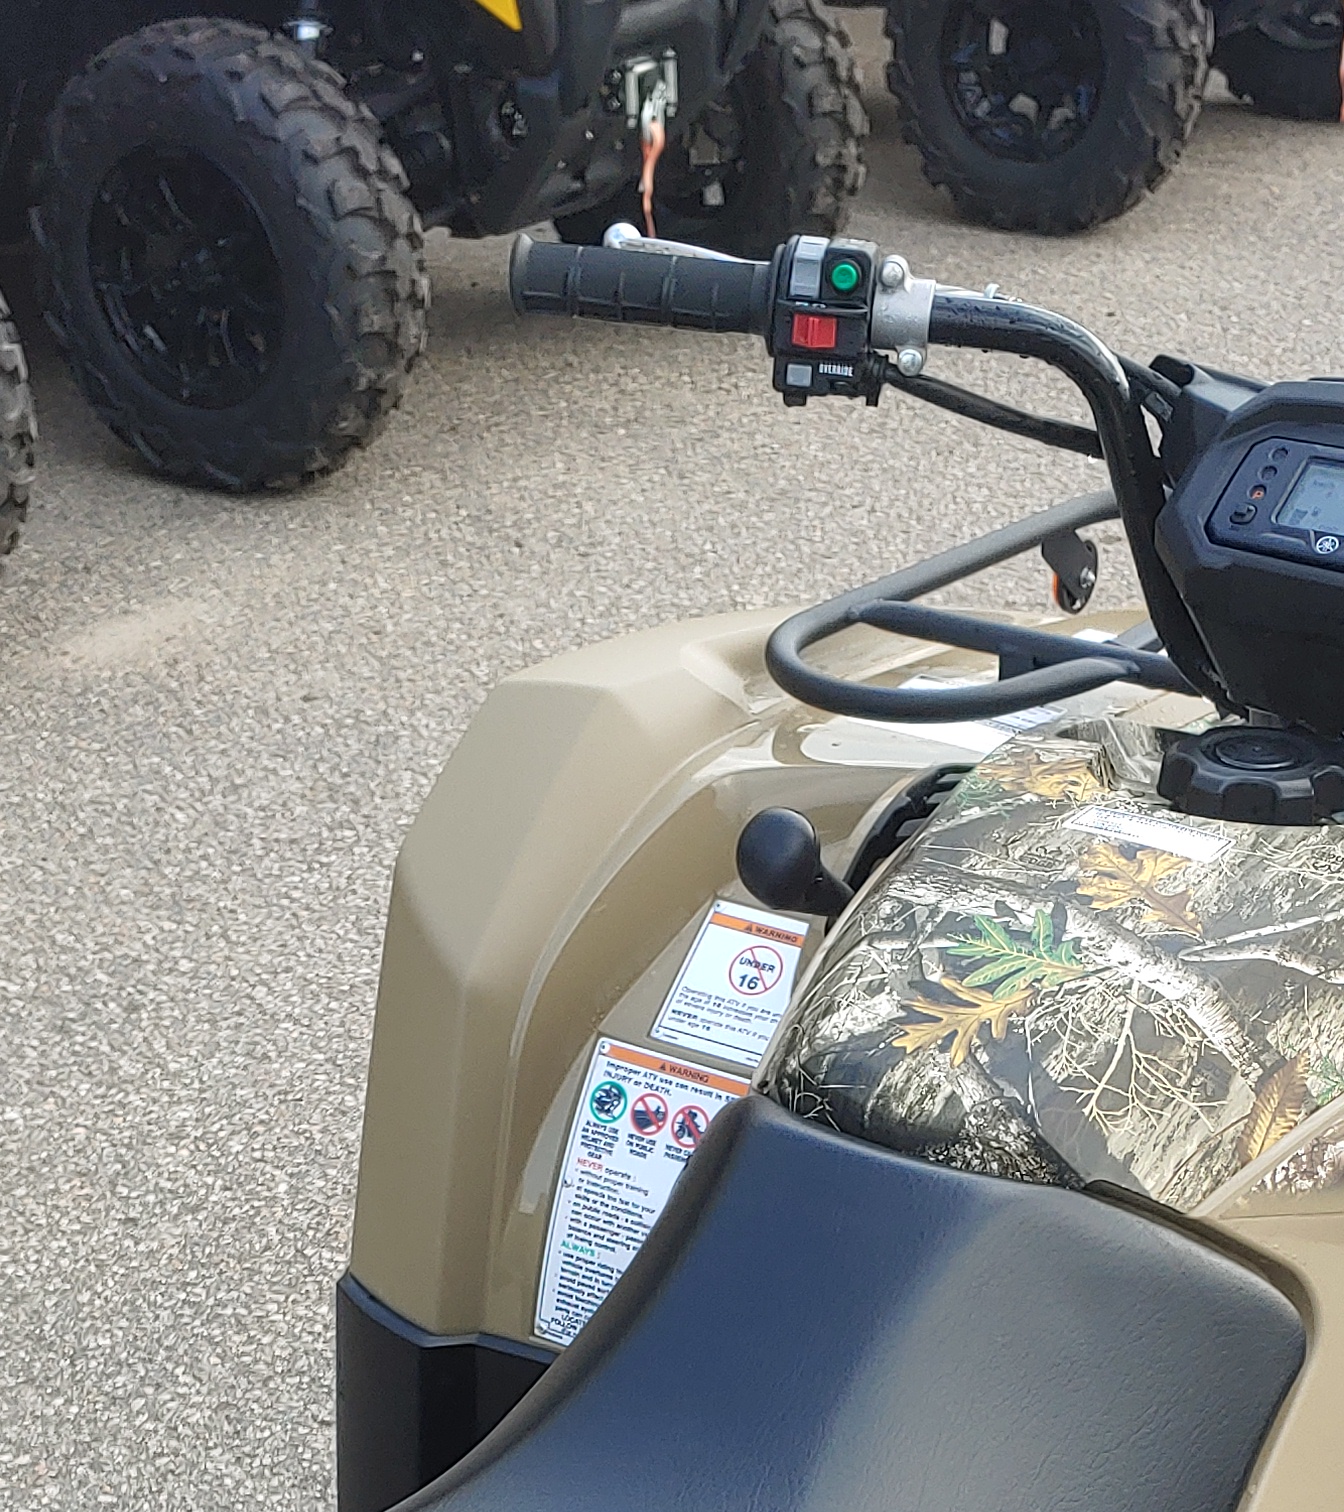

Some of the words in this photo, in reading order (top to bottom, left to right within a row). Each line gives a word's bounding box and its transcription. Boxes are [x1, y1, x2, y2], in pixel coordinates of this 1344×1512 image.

[754, 925, 798, 943] WARNING
[738, 955, 776, 973] UNDER
[738, 972, 762, 991] 16
[641, 1070, 659, 1081] ATV
[668, 1063, 709, 1084] WARNING
